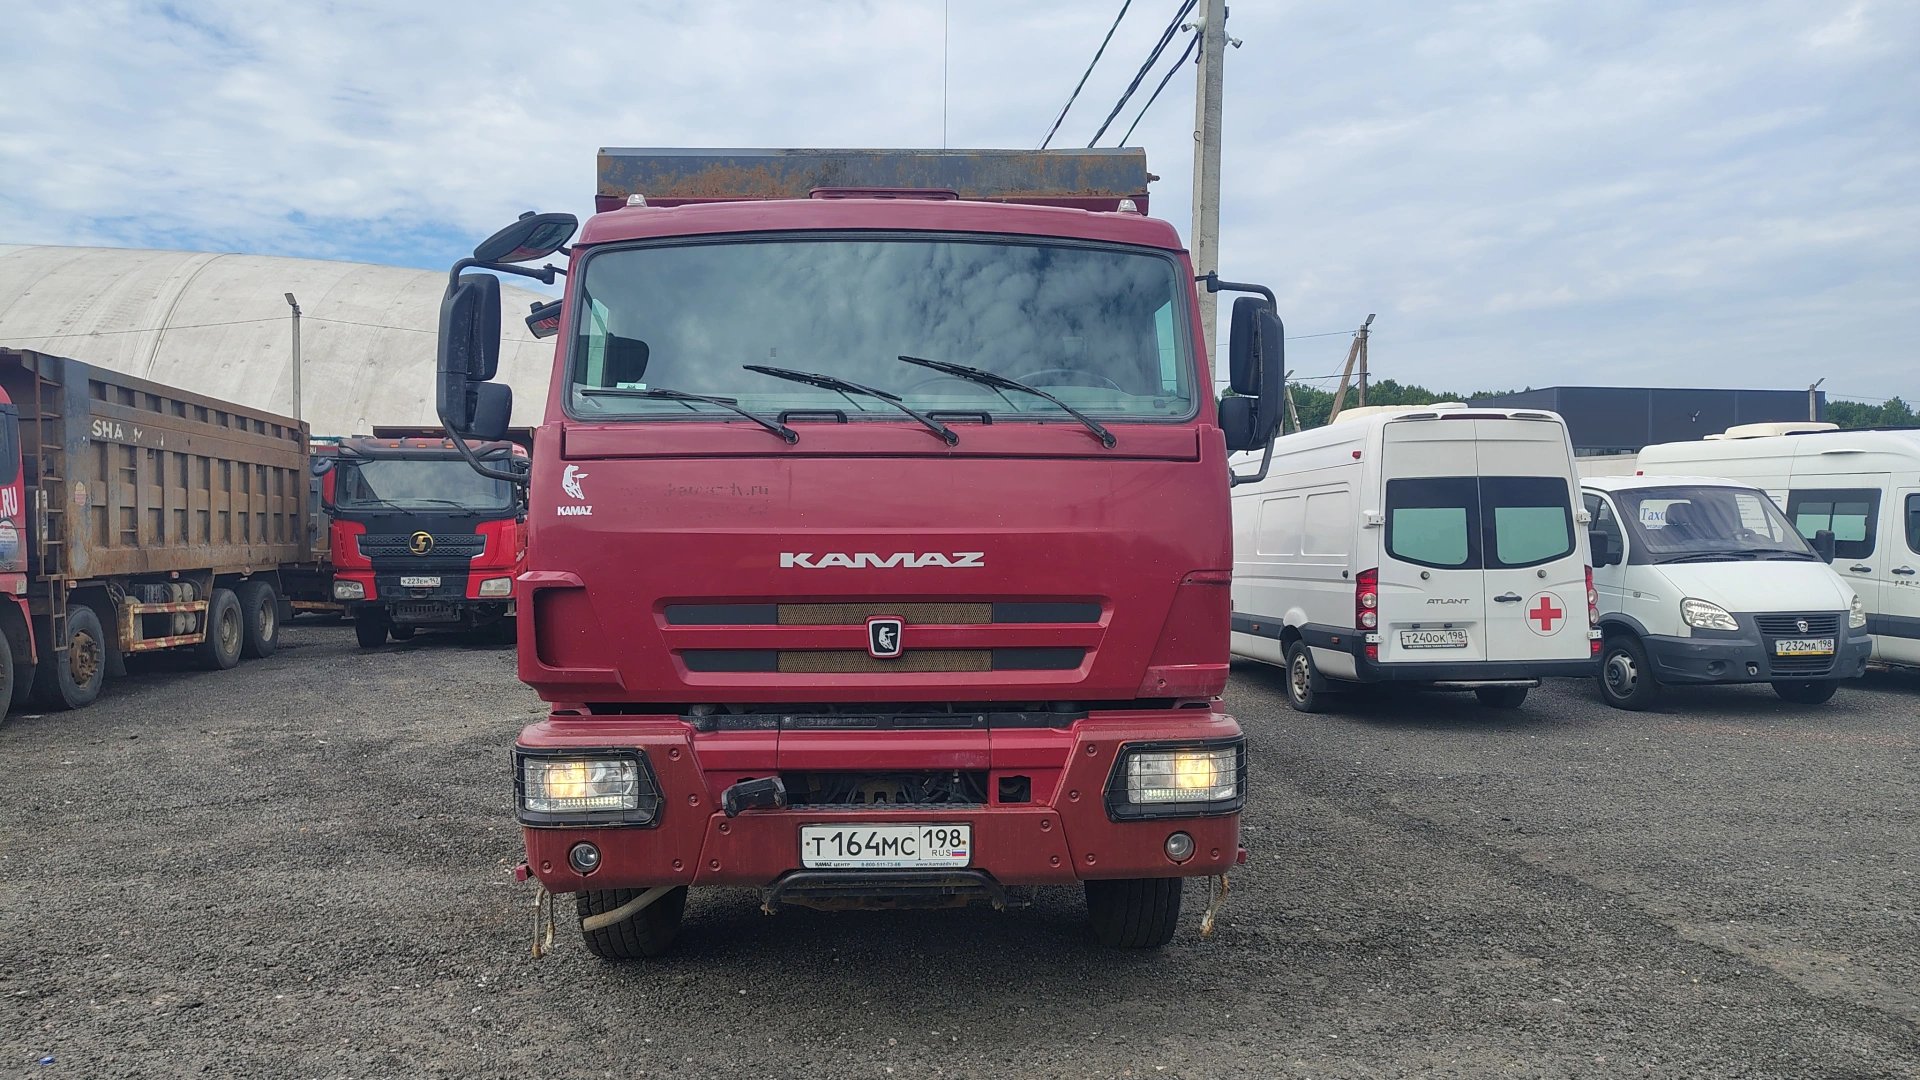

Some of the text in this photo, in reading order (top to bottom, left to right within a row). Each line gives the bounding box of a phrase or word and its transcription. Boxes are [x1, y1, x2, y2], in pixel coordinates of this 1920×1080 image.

[557, 505, 593, 516] KAMAZ
[779, 552, 985, 569] KAMAZ
[1448, 631, 1463, 640] 198
[1819, 640, 1832, 648] 198
[811, 828, 961, 857] Т164МС 198
[931, 849, 951, 857] RUS
